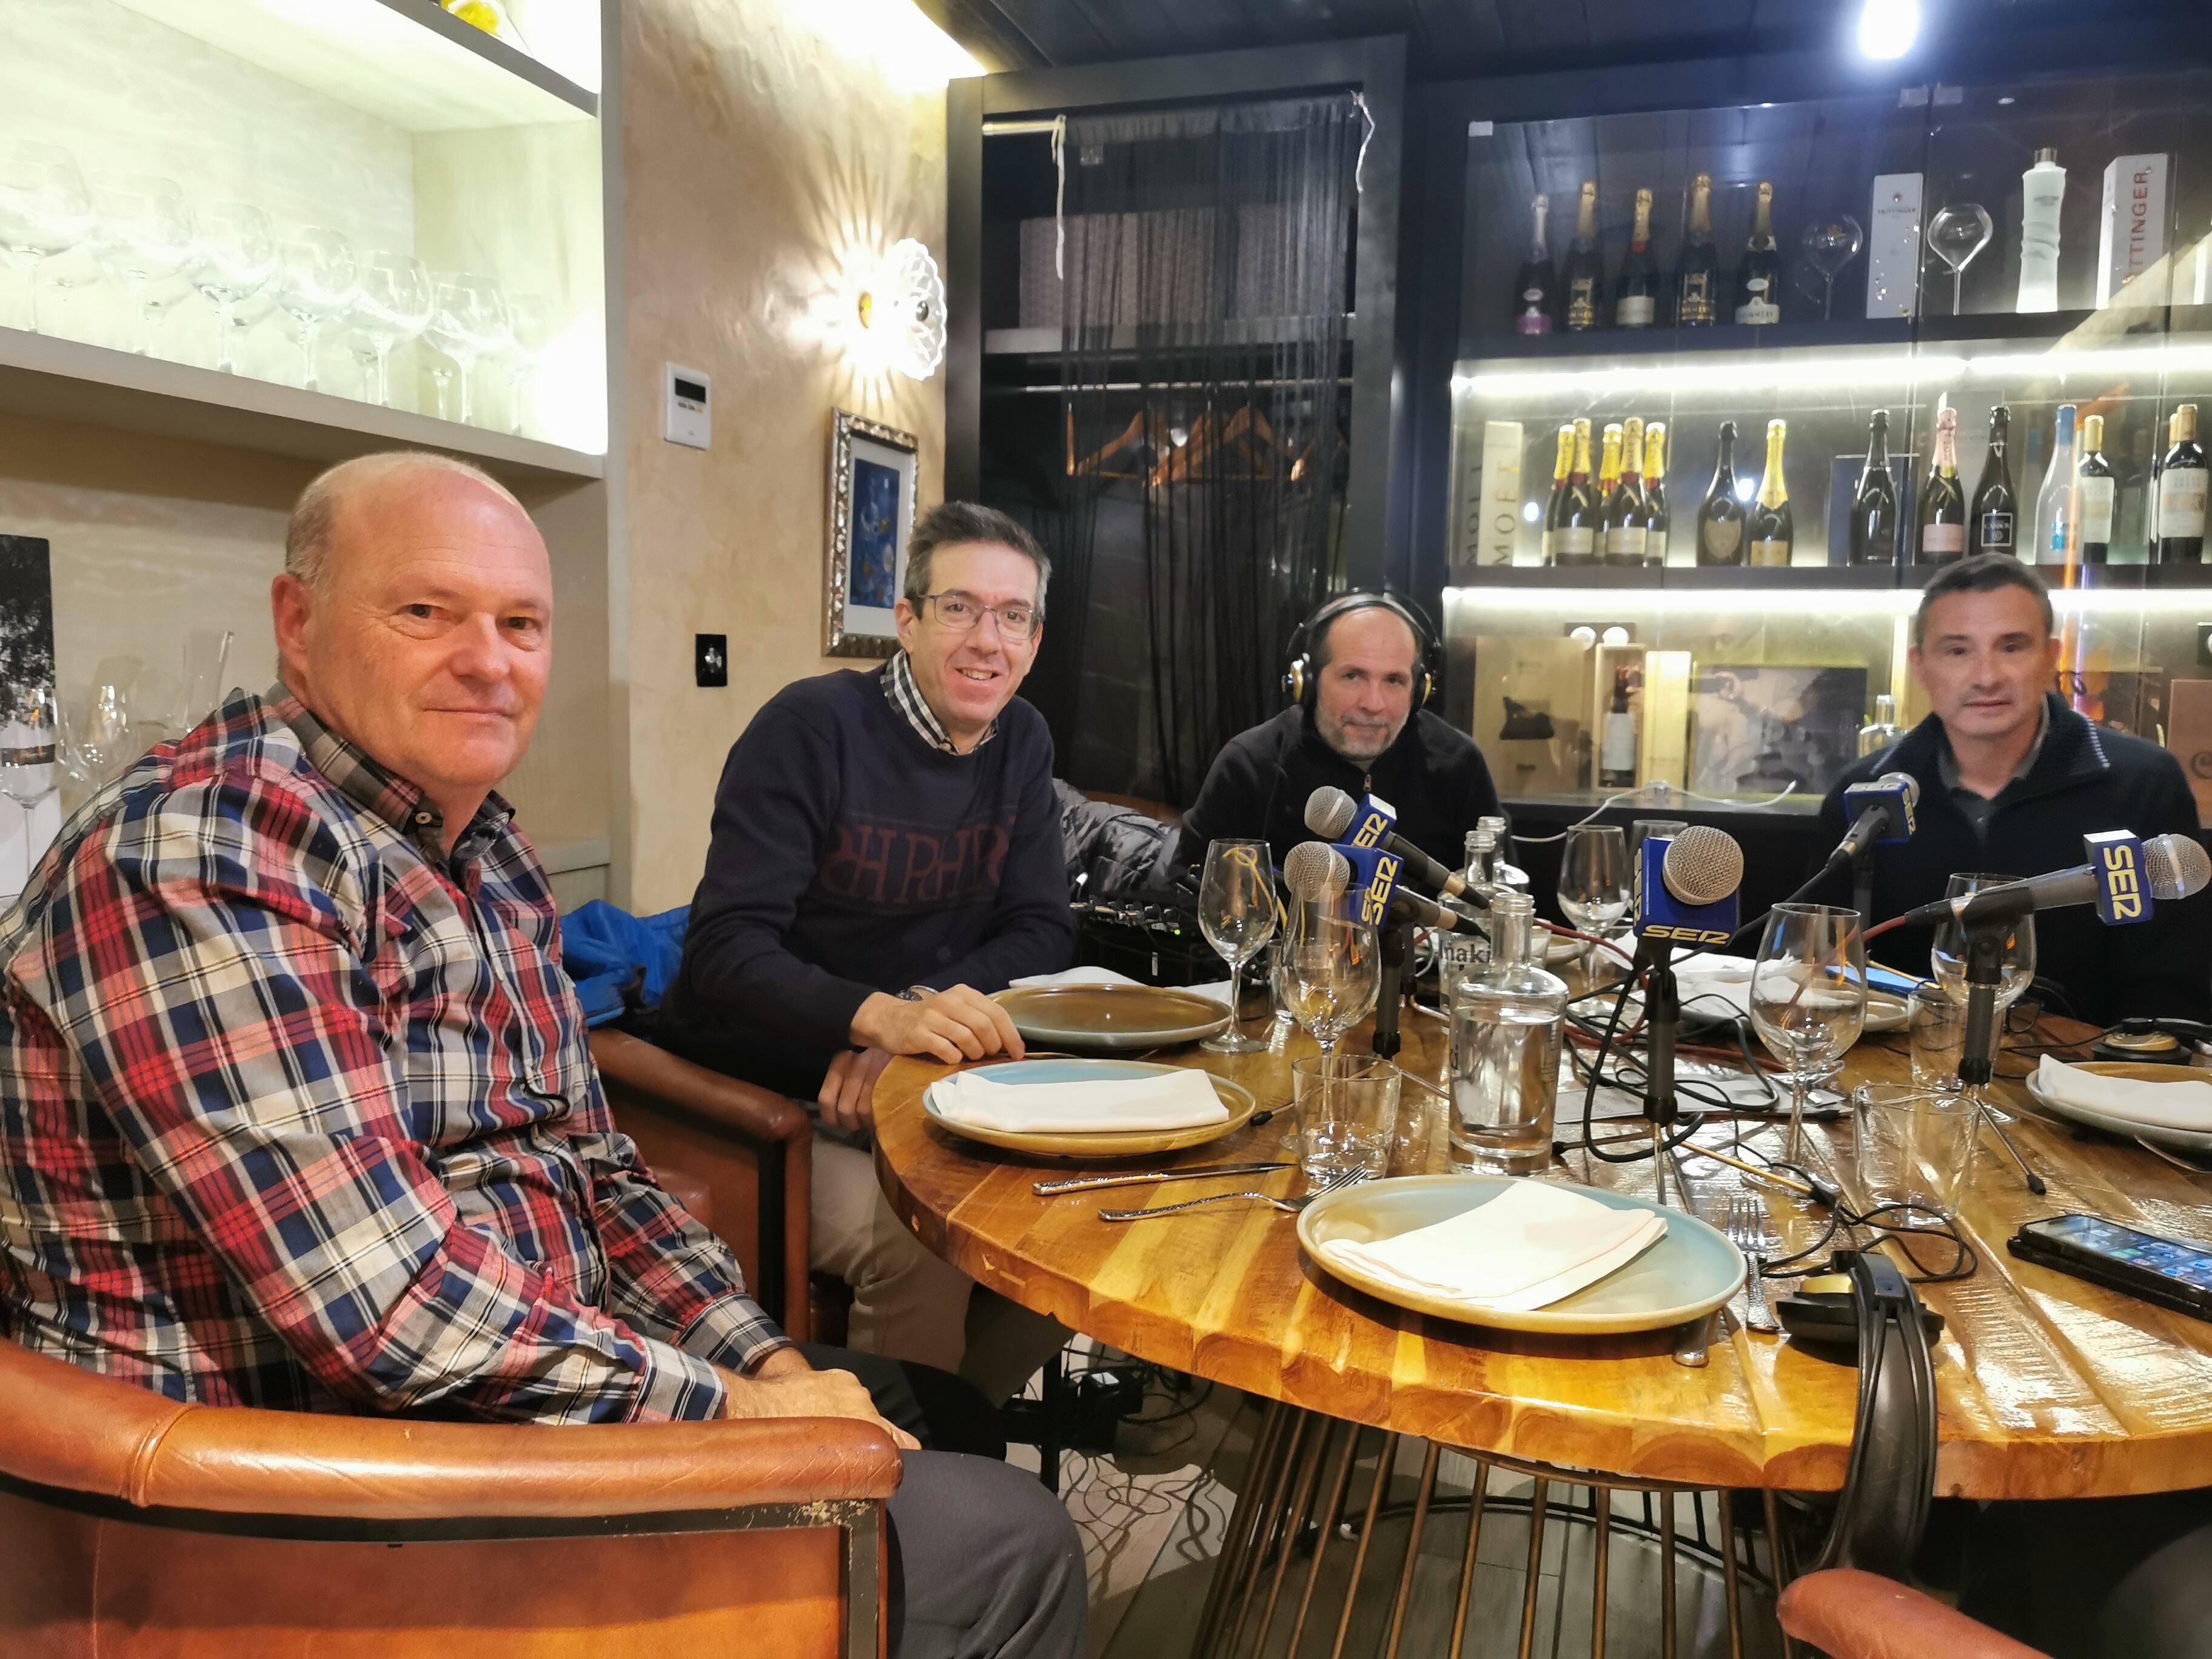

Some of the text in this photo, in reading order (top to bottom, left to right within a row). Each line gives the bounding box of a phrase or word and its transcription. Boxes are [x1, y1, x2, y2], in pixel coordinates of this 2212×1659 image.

[1352, 813, 1388, 848] ER
[1361, 856, 1398, 926] SER
[2103, 845, 2142, 920] SER
[1641, 925, 1731, 945] SER
